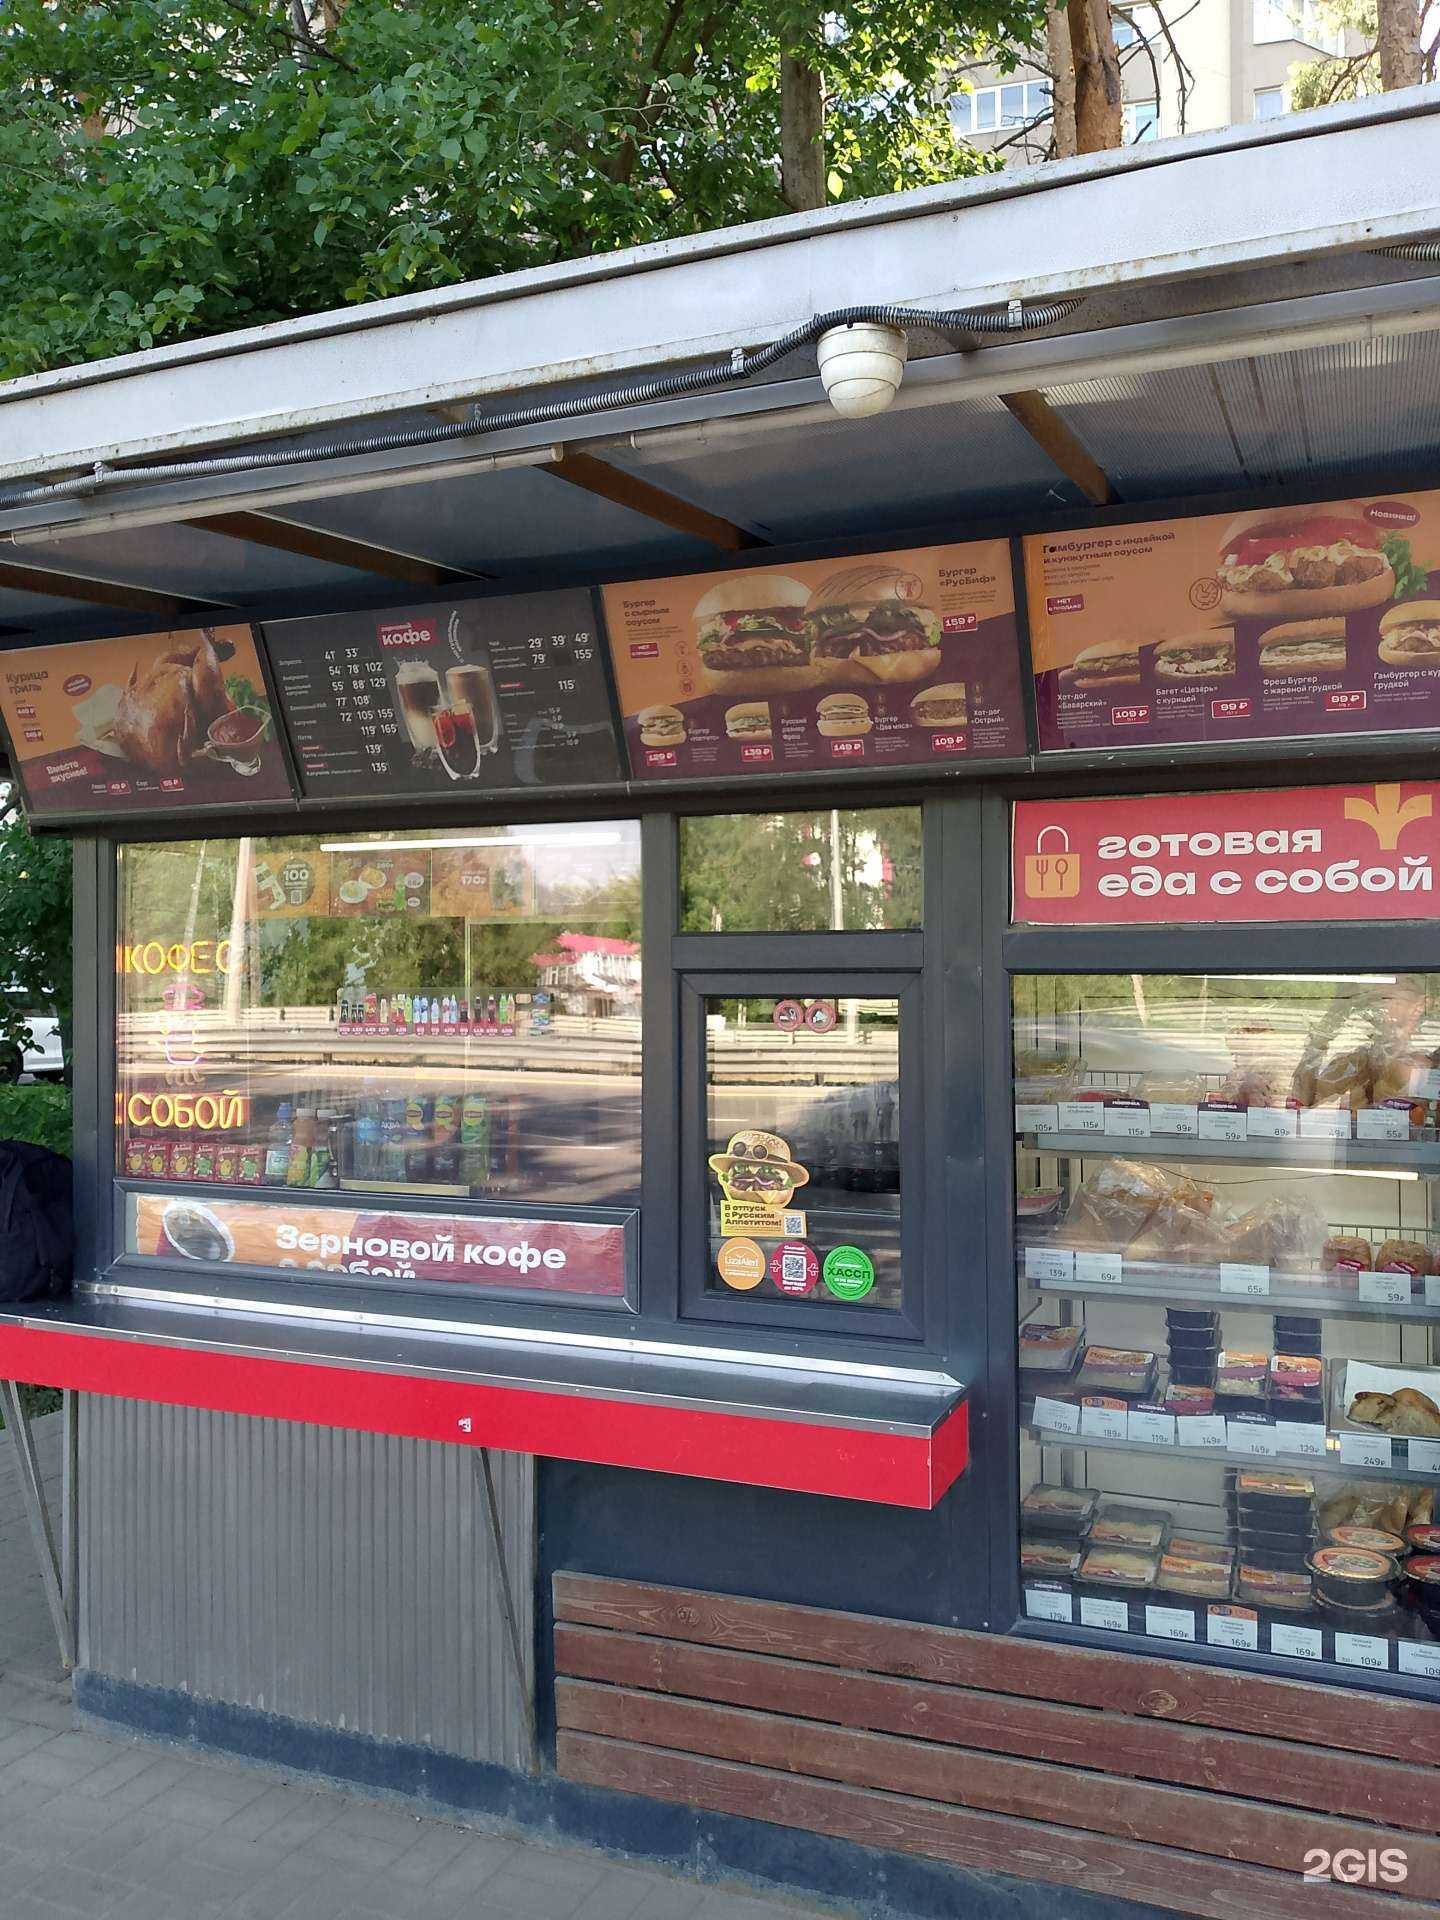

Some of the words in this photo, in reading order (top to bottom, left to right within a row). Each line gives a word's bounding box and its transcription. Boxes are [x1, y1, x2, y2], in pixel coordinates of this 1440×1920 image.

[1042, 538, 1113, 554] Гамбургер
[1122, 532, 1175, 545] индейкой
[1051, 550, 1113, 564] кунжутным
[1114, 547, 1153, 557] соусом
[938, 567, 977, 577] Бургер
[382, 628, 430, 646] кофе
[1287, 676, 1318, 684] Бургер
[1373, 671, 1419, 680] Гамбургер
[1270, 686, 1307, 694] жареной
[1308, 682, 1343, 692] грудкой
[1373, 680, 1409, 690] грудкой
[1057, 692, 1088, 701] Хот-дог
[1156, 688, 1178, 696] Багет
[1162, 695, 1196, 704] курицей
[1331, 695, 1349, 703] 99
[1220, 703, 1237, 711] 99
[1115, 711, 1137, 719] 109
[1097, 829, 1322, 860] готовая
[1097, 865, 1196, 897] еда
[1209, 870, 1242, 895] с
[1255, 855, 1433, 894] собой
[127, 1089, 244, 1130] СОБОЙ
[276, 1225, 454, 1262] Зерновой
[463, 1241, 567, 1274] кофе
[828, 1267, 871, 1279] ХАССП
